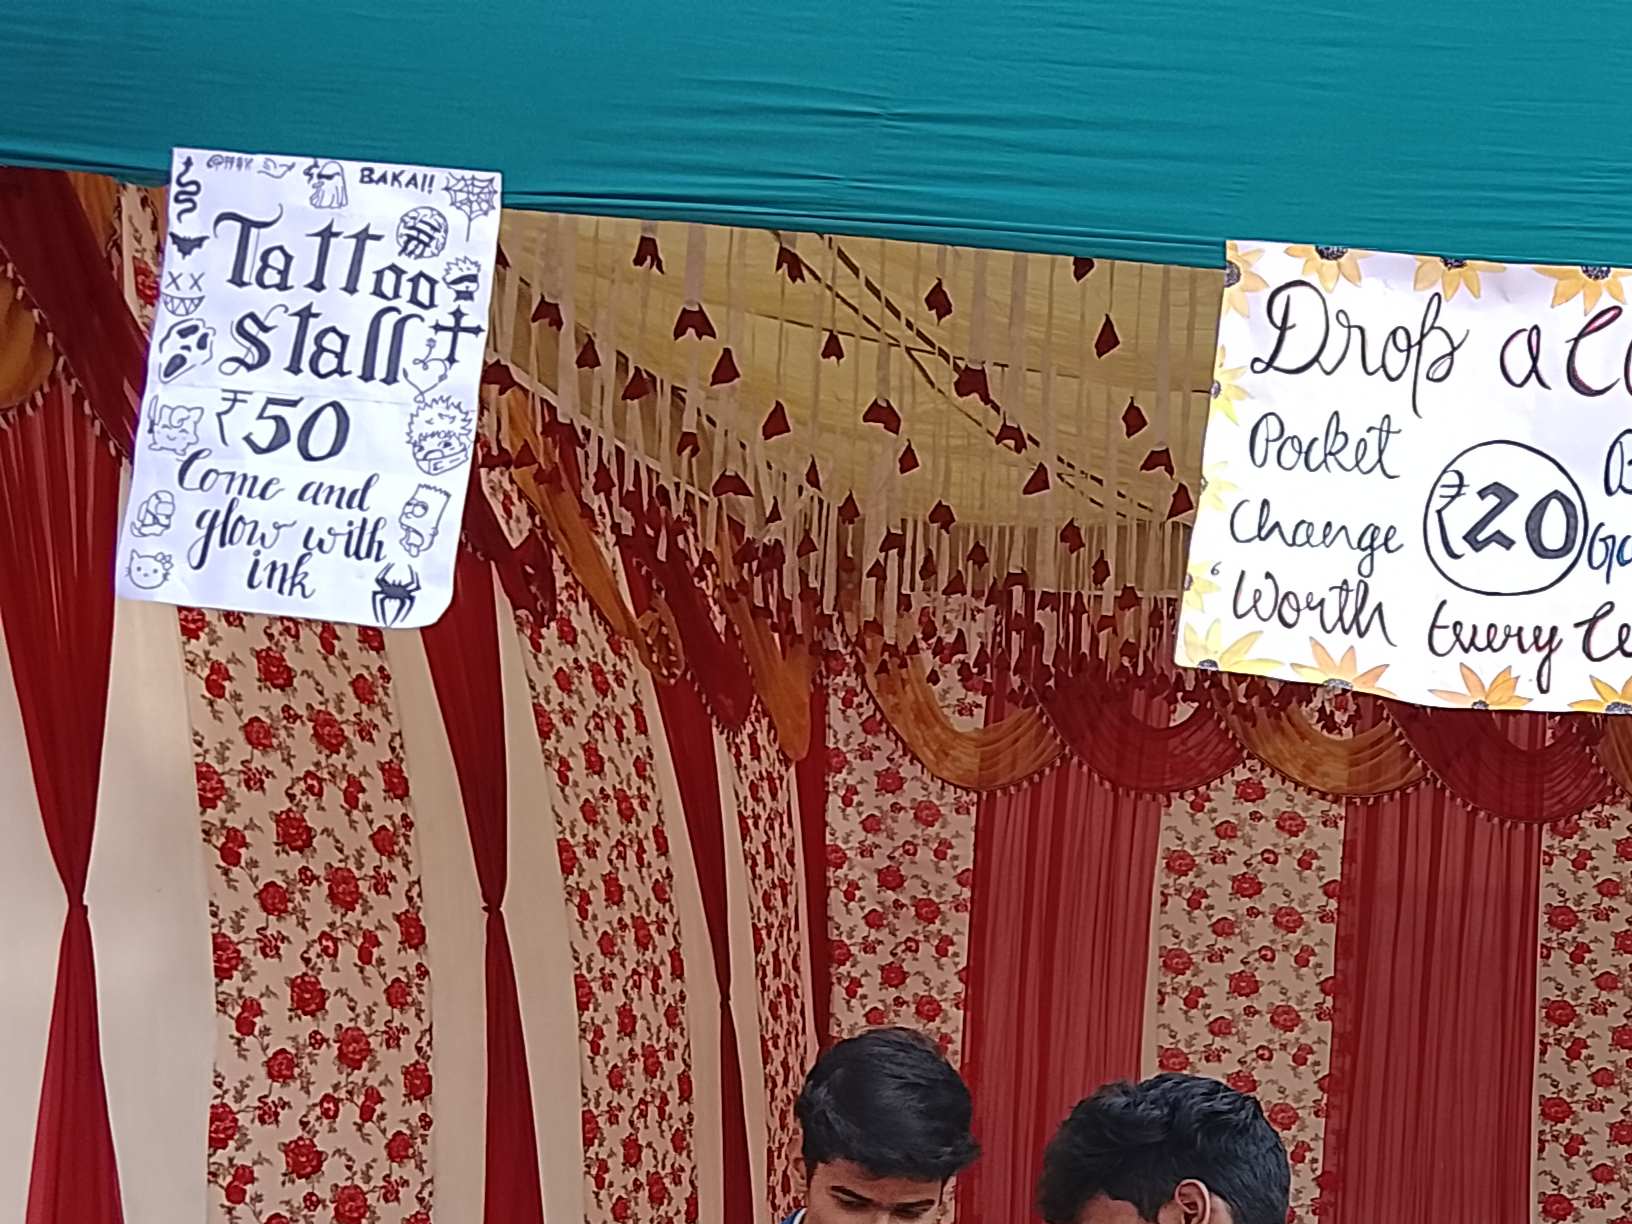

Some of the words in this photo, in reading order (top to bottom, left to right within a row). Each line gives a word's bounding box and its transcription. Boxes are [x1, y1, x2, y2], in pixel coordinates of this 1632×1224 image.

[359, 166, 435, 194] BAKA!!
[213, 203, 438, 311] Tattoo
[219, 301, 426, 385] Stall
[1250, 279, 1470, 418] Drop
[1500, 324, 1552, 390] a
[215, 388, 351, 462] ₹50
[1249, 411, 1402, 479] Pocket
[177, 449, 286, 501] Come
[297, 472, 380, 512] and
[1435, 469, 1579, 560] ₹20
[187, 497, 297, 570] glow
[302, 516, 387, 562] with
[1229, 499, 1404, 578] Change
[246, 551, 315, 599] ink
[1427, 600, 1564, 694] Every
